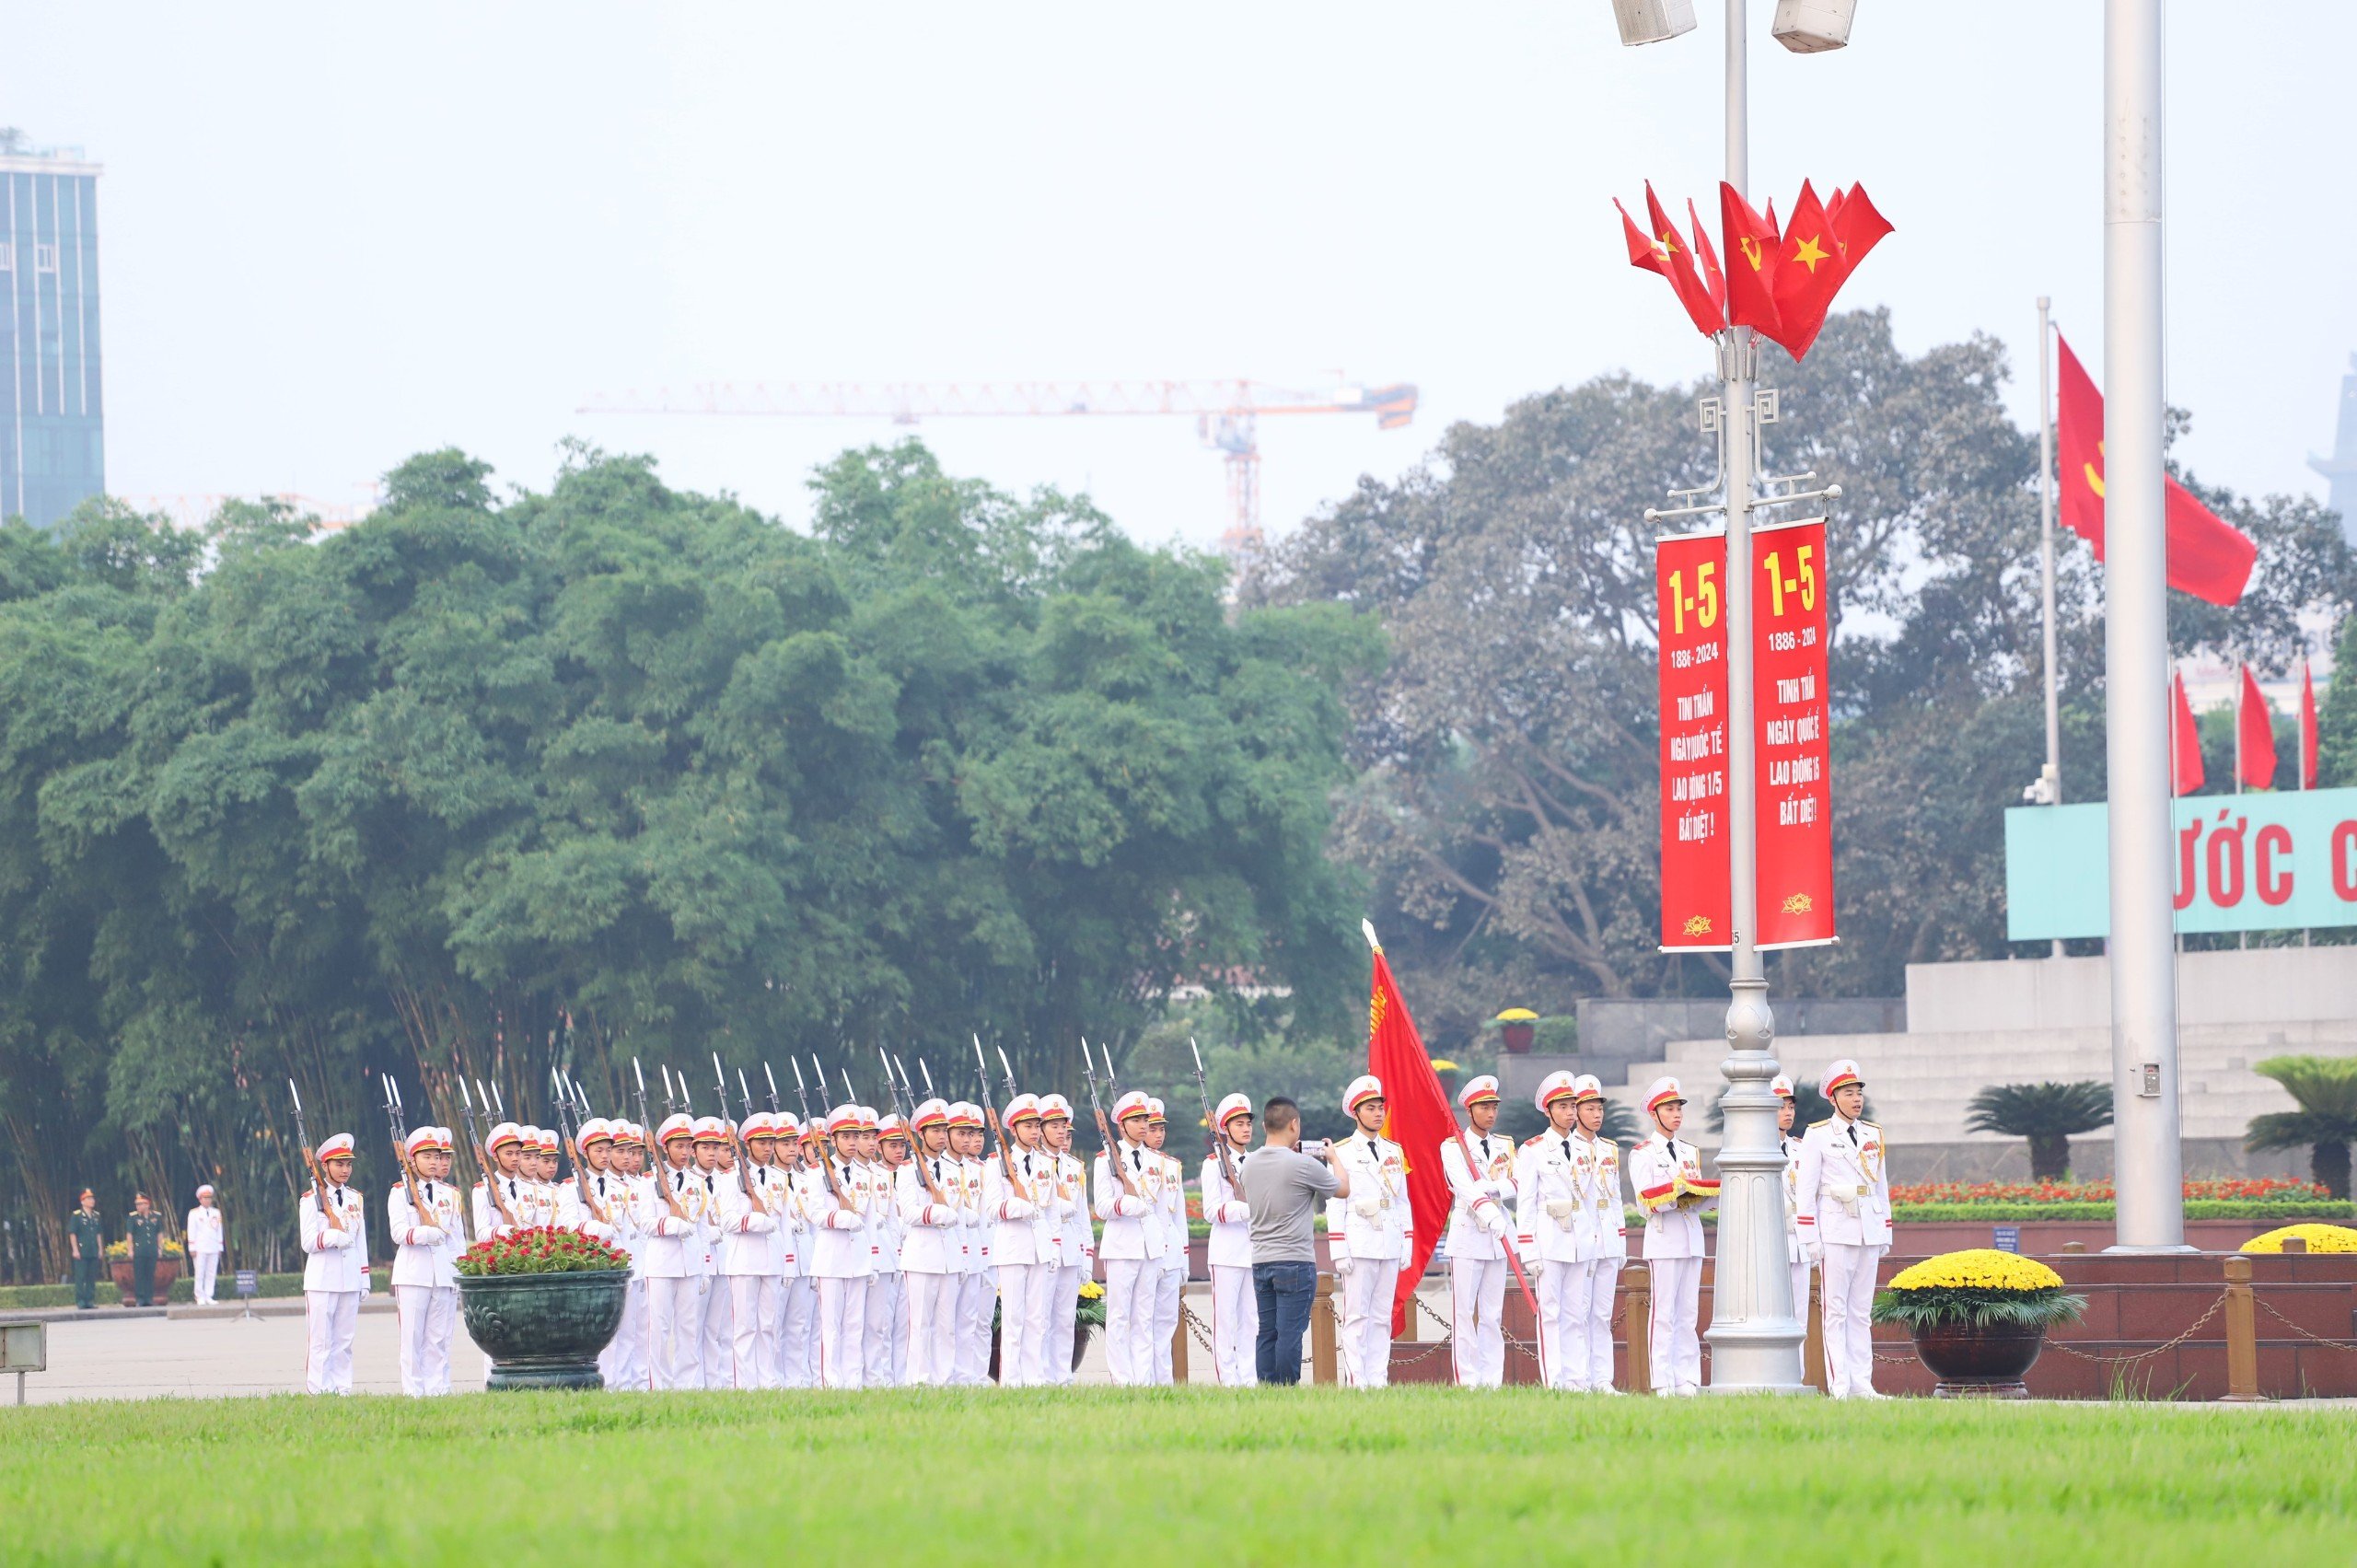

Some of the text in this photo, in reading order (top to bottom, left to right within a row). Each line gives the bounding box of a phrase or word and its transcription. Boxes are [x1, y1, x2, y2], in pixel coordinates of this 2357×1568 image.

[1764, 545, 1815, 616] 1-5
[1669, 562, 1717, 633] 1-5
[1769, 632, 1794, 651] 1886
[1802, 626, 1816, 646] 2024
[1777, 678, 1799, 703] TINH
[1671, 721, 1723, 762] NGÀY QUỐC TẾ
[1767, 714, 1794, 745] NGÀY
[1673, 777, 1687, 801] LAO
[1708, 771, 1722, 796] 1/5
[1770, 761, 1789, 785] LAO
[1792, 754, 1812, 788] ĐỘNG
[1679, 808, 1692, 841] BẤT
[1780, 792, 1798, 825] BẤT
[2173, 808, 2293, 910] ƯỚC
